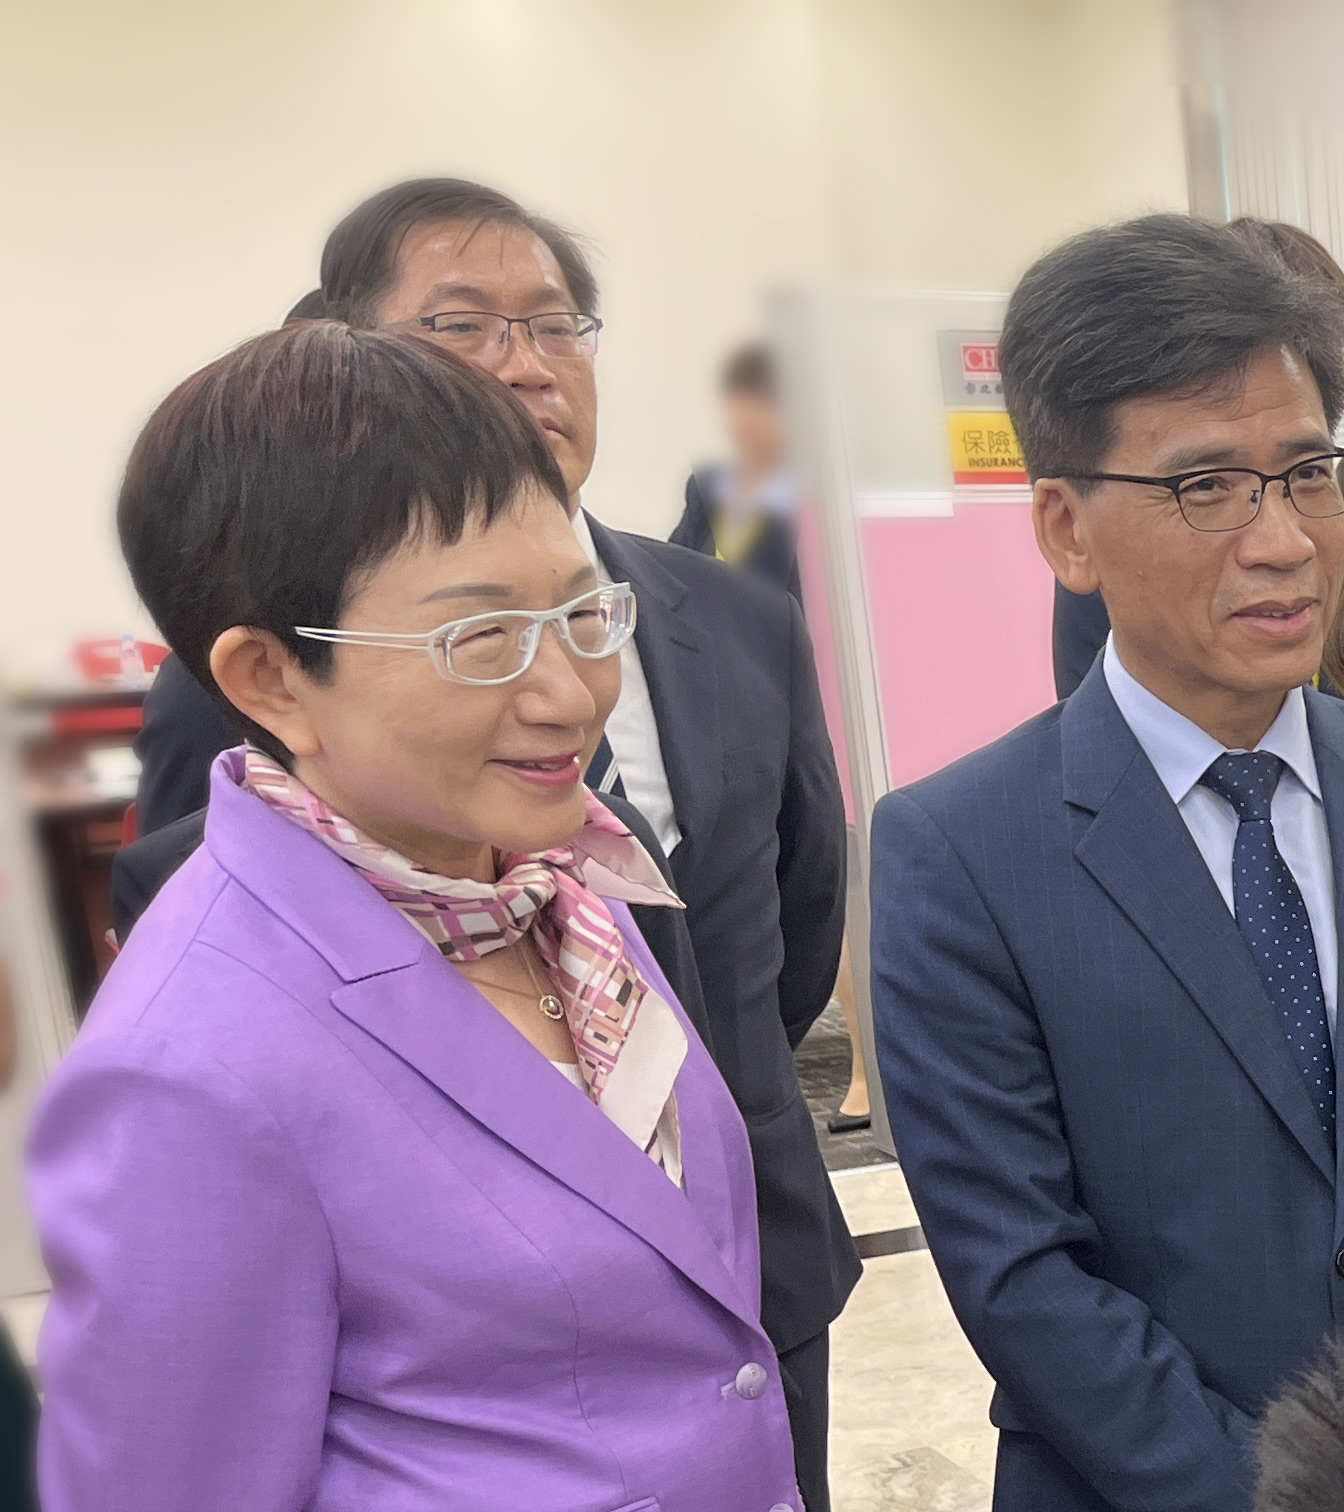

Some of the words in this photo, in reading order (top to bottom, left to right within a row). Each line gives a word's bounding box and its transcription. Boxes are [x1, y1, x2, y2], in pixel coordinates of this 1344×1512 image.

[964, 347, 999, 370] CH
[962, 429, 1024, 455] 保險
[967, 456, 1023, 468] INSURANC
